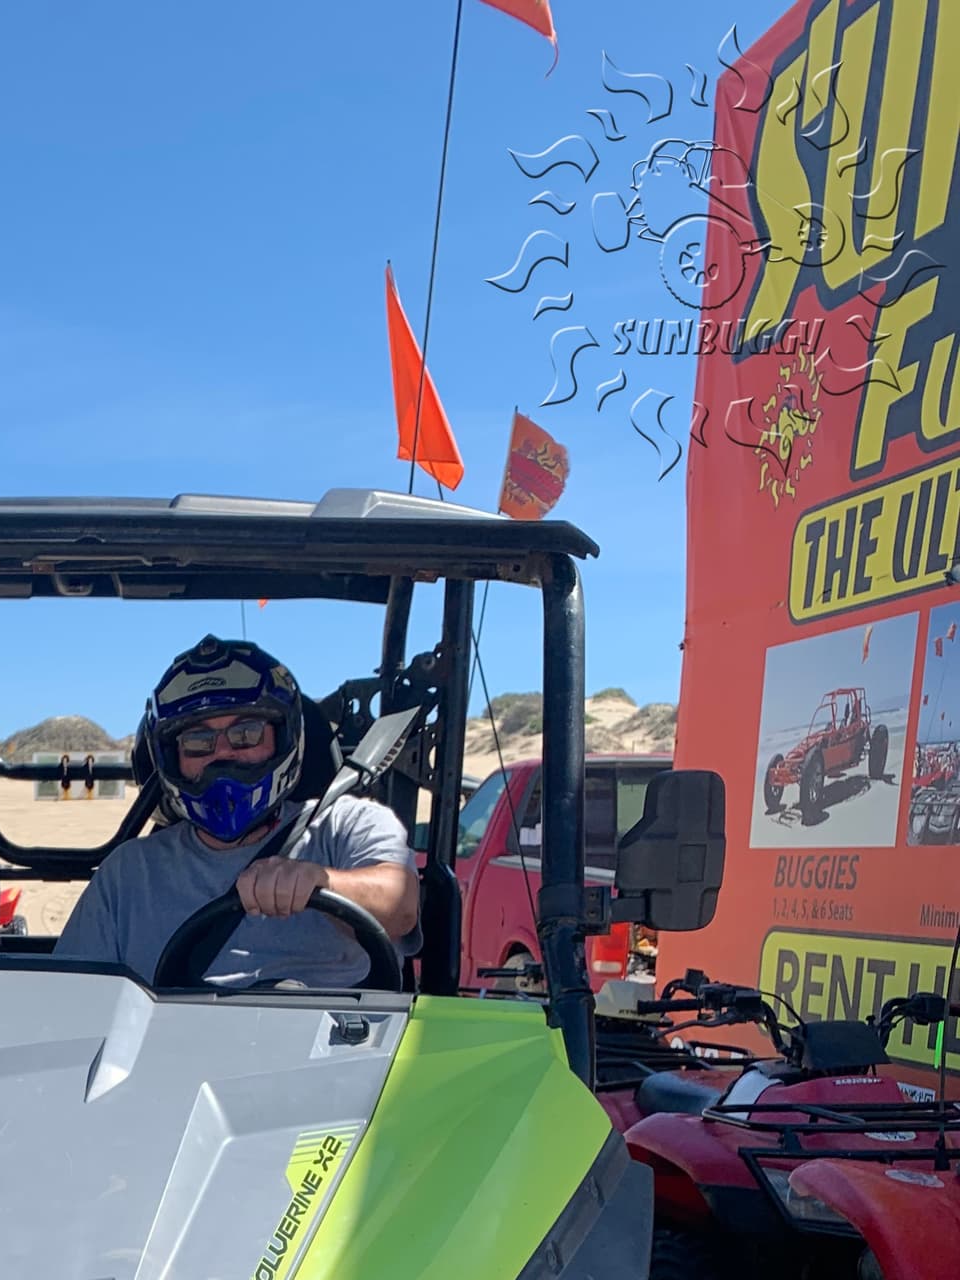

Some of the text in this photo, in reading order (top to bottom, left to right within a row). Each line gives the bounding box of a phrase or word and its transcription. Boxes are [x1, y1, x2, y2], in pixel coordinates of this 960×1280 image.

[802, 496, 885, 610] THE
[773, 855, 860, 890] BUGGIES
[827, 900, 854, 921] Seats
[773, 948, 896, 1025] RENT
[313, 1135, 343, 1172] X2
